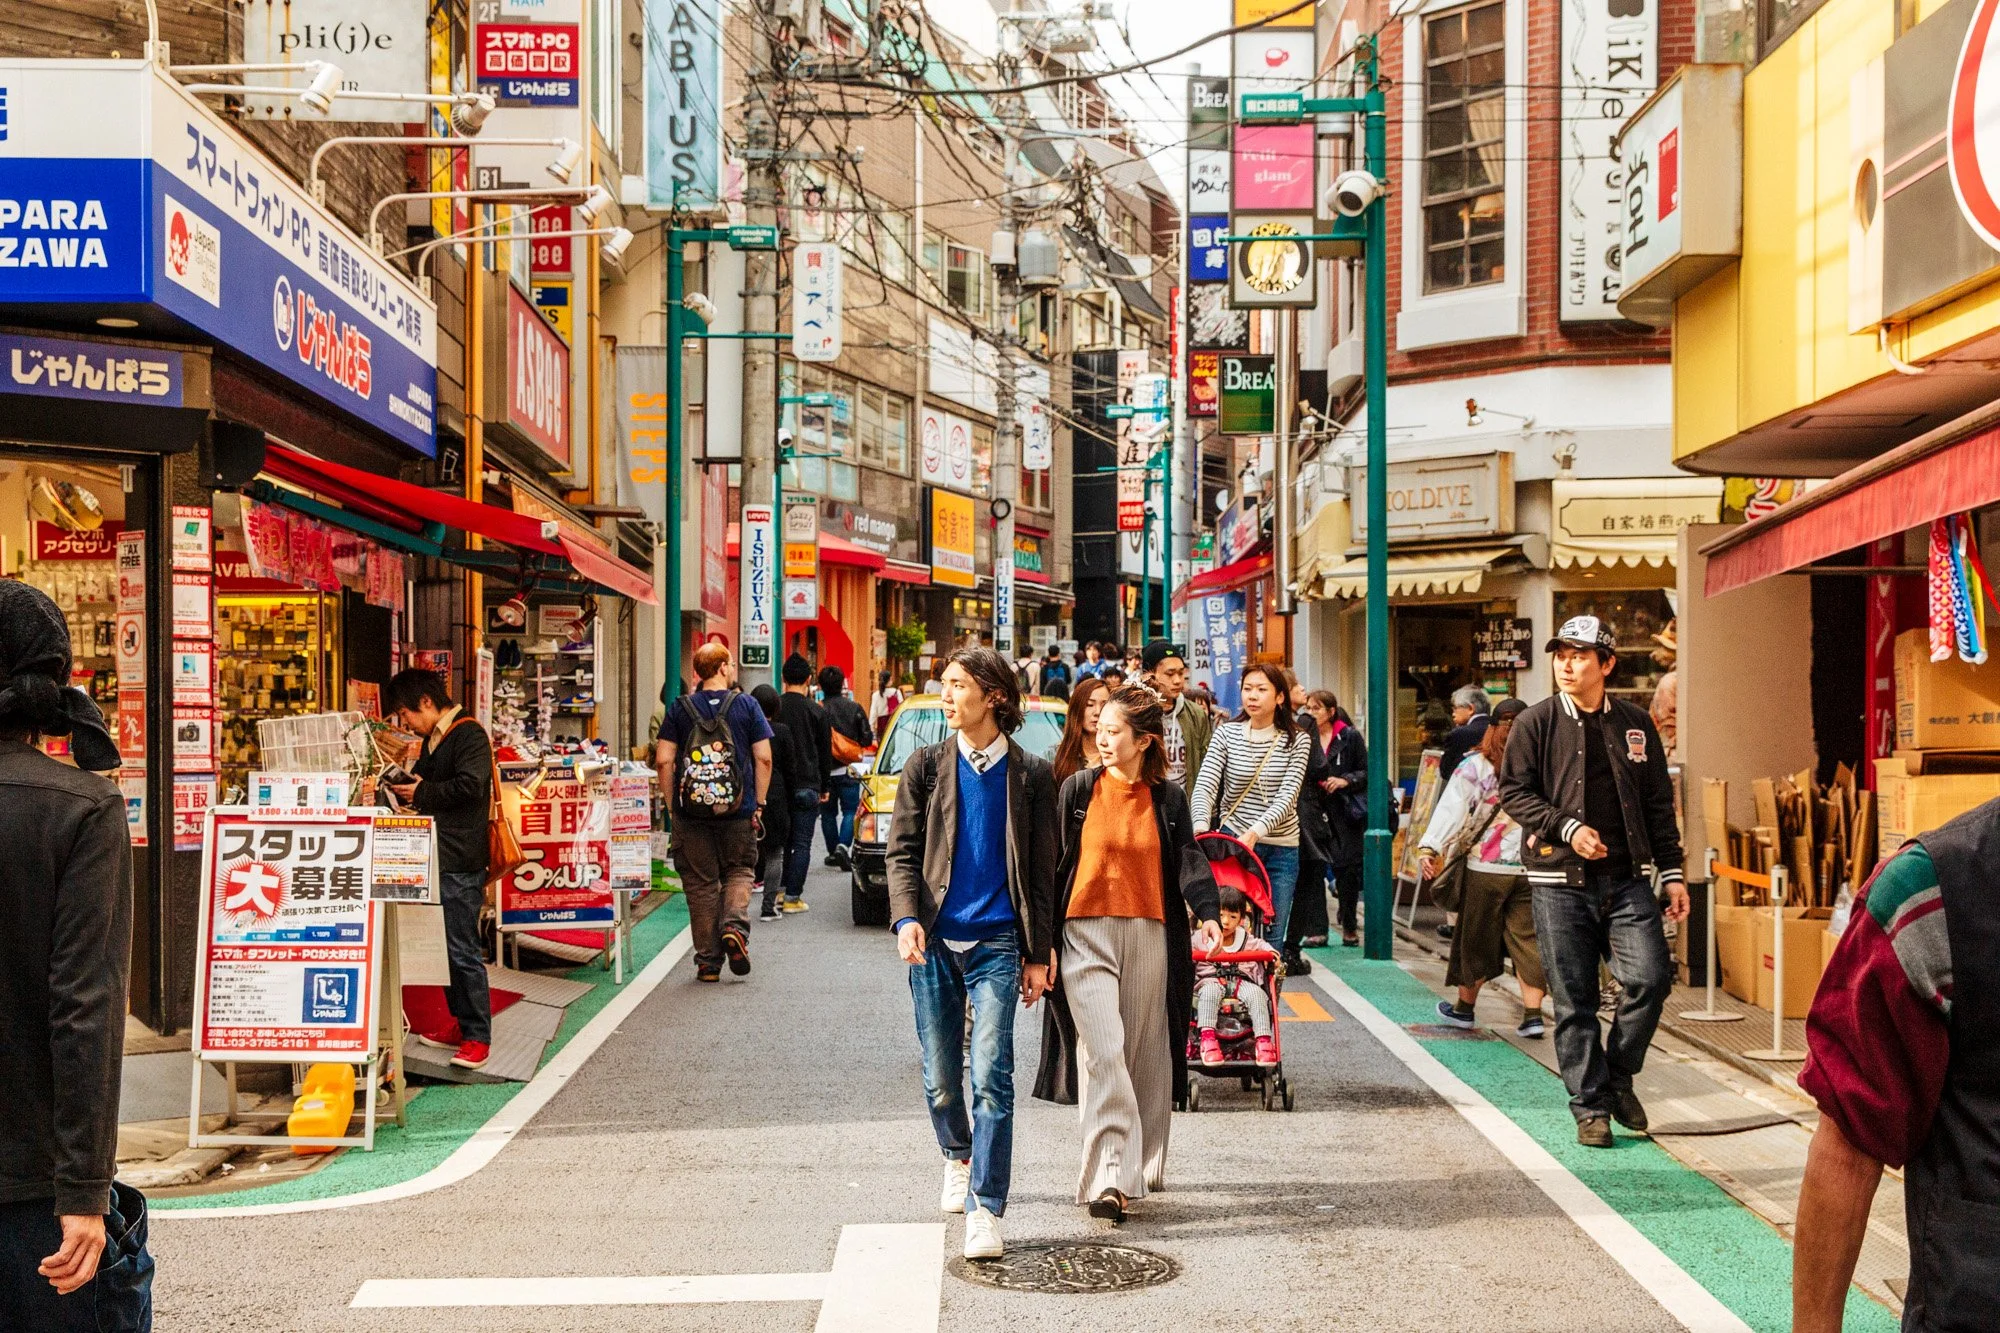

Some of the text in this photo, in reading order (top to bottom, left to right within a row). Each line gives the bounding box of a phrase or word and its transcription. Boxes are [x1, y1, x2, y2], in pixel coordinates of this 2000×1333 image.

[479, 2, 499, 22] 2F
[279, 22, 393, 55] pli(j)e
[485, 31, 571, 50] スマホ・PC
[486, 51, 570, 72] 高価買取
[508, 81, 571, 97] じゃんぱら
[668, 3, 698, 186] ABIUS
[479, 169, 498, 190] B1
[0, 200, 108, 230] PARA
[0, 237, 108, 268] ZAWA
[296, 288, 372, 400] じゃんぱら
[11, 348, 170, 394] じゃんぱら
[1224, 358, 1276, 390] BREA
[751, 529, 764, 621] ISUZUYA
[174, 792, 208, 808] 買取
[222, 829, 366, 862] スタッフ
[514, 848, 603, 892] 5%UP
[223, 863, 364, 917] 大 募集
